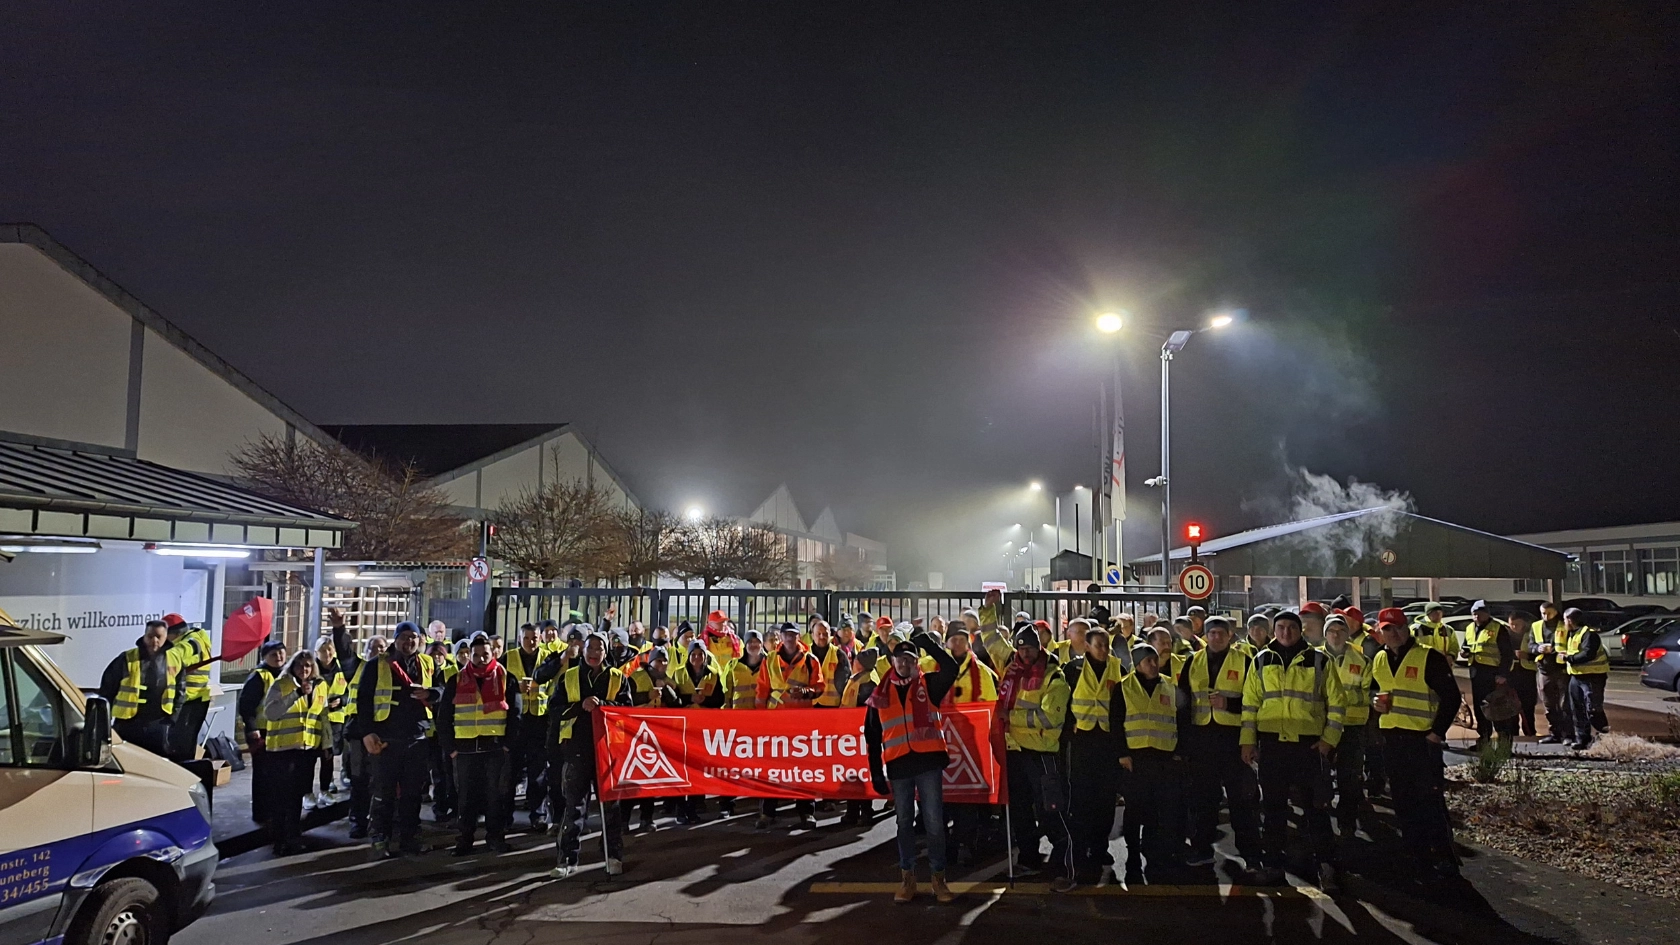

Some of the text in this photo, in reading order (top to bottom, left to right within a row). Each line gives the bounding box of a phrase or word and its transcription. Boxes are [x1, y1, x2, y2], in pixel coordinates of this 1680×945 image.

[1188, 574, 1205, 590] 10
[703, 763, 873, 784] unser gutes Rec
[33, 850, 51, 862] 142
